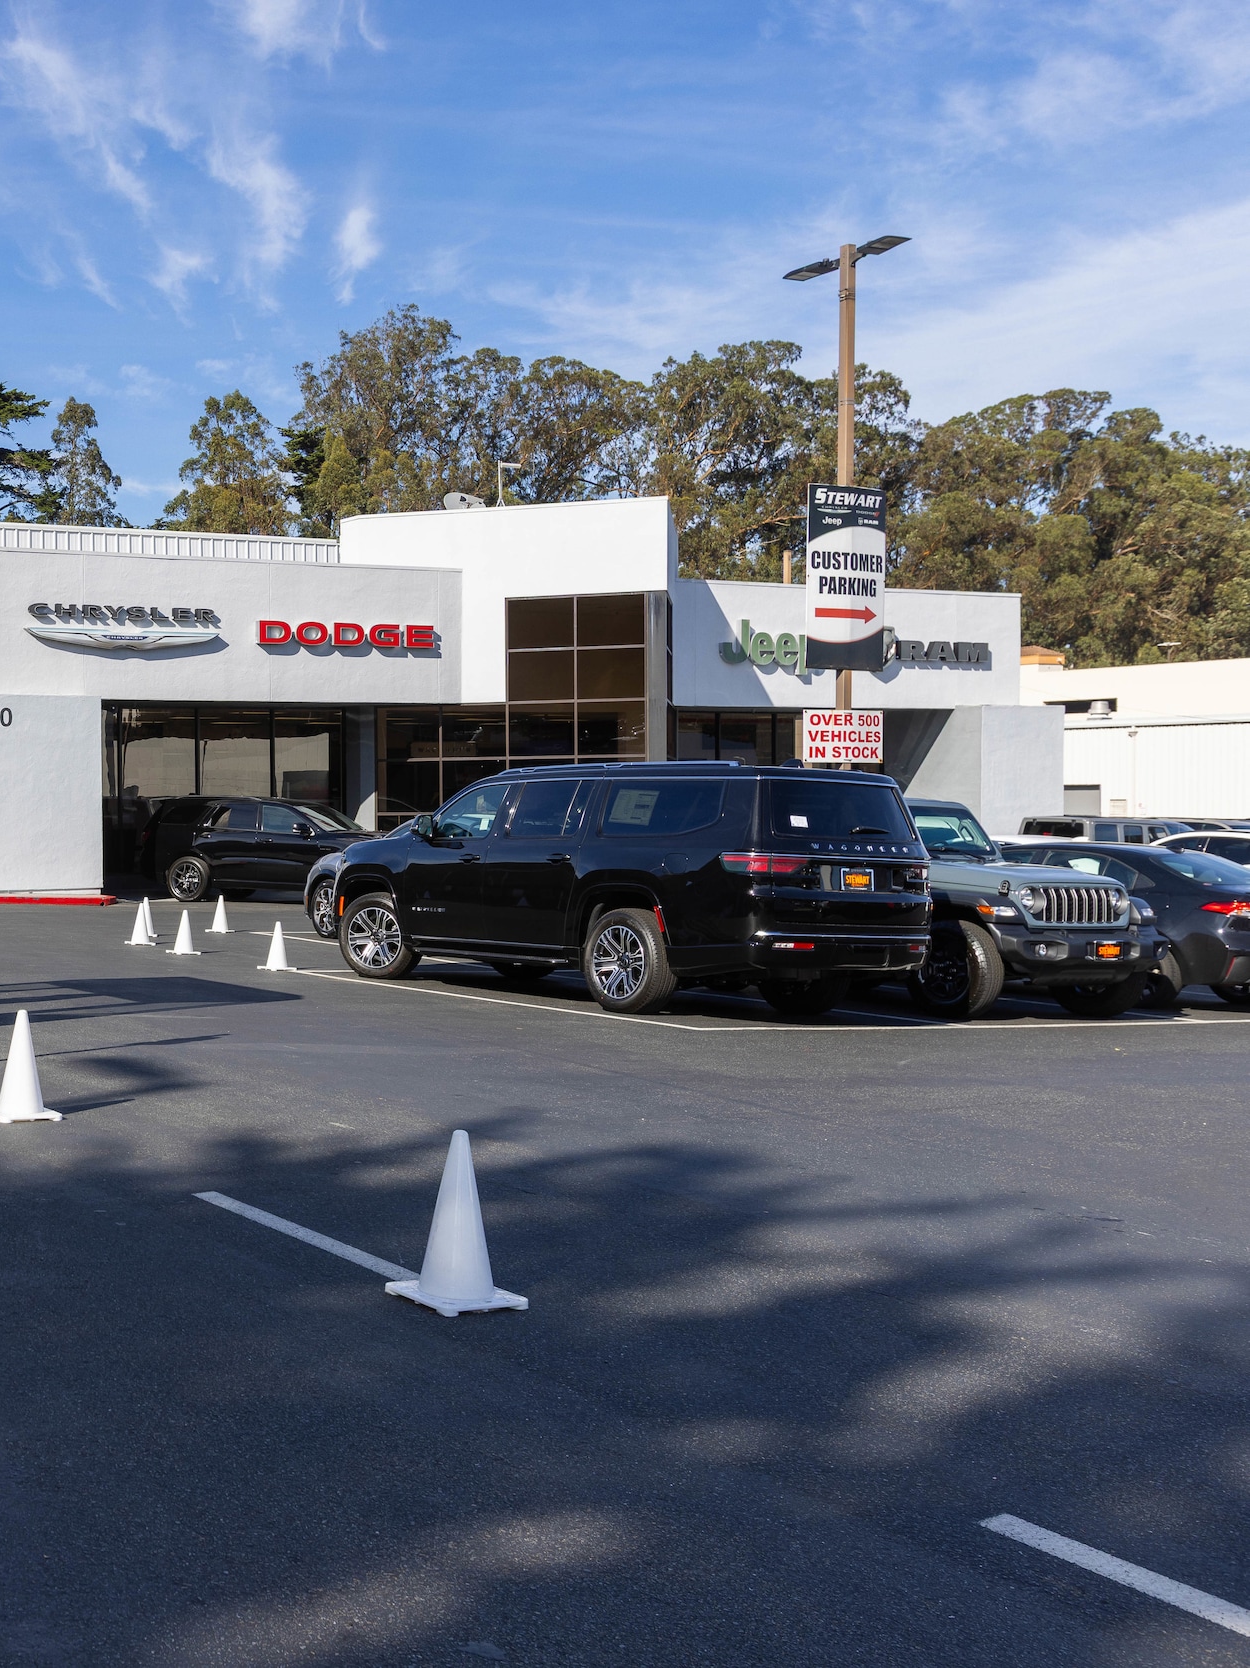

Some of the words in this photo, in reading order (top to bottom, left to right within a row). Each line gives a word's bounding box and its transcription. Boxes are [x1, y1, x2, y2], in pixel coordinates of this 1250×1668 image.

[814, 488, 882, 508] STEWART
[822, 516, 842, 526] Jeep
[811, 550, 883, 573] CUSTOMER
[819, 576, 877, 597] PARKING
[28, 602, 216, 622] CHRYSLER
[256, 620, 435, 648] DODGE
[718, 619, 807, 675] Jee
[897, 640, 989, 662] RAM
[809, 714, 853, 726] OVER
[858, 714, 880, 727] 500
[808, 730, 881, 743] VEHICLES
[809, 746, 826, 758] IN
[832, 746, 879, 759] STOCK
[811, 843, 909, 853] WAGONEER
[845, 873, 870, 885] STEWART
